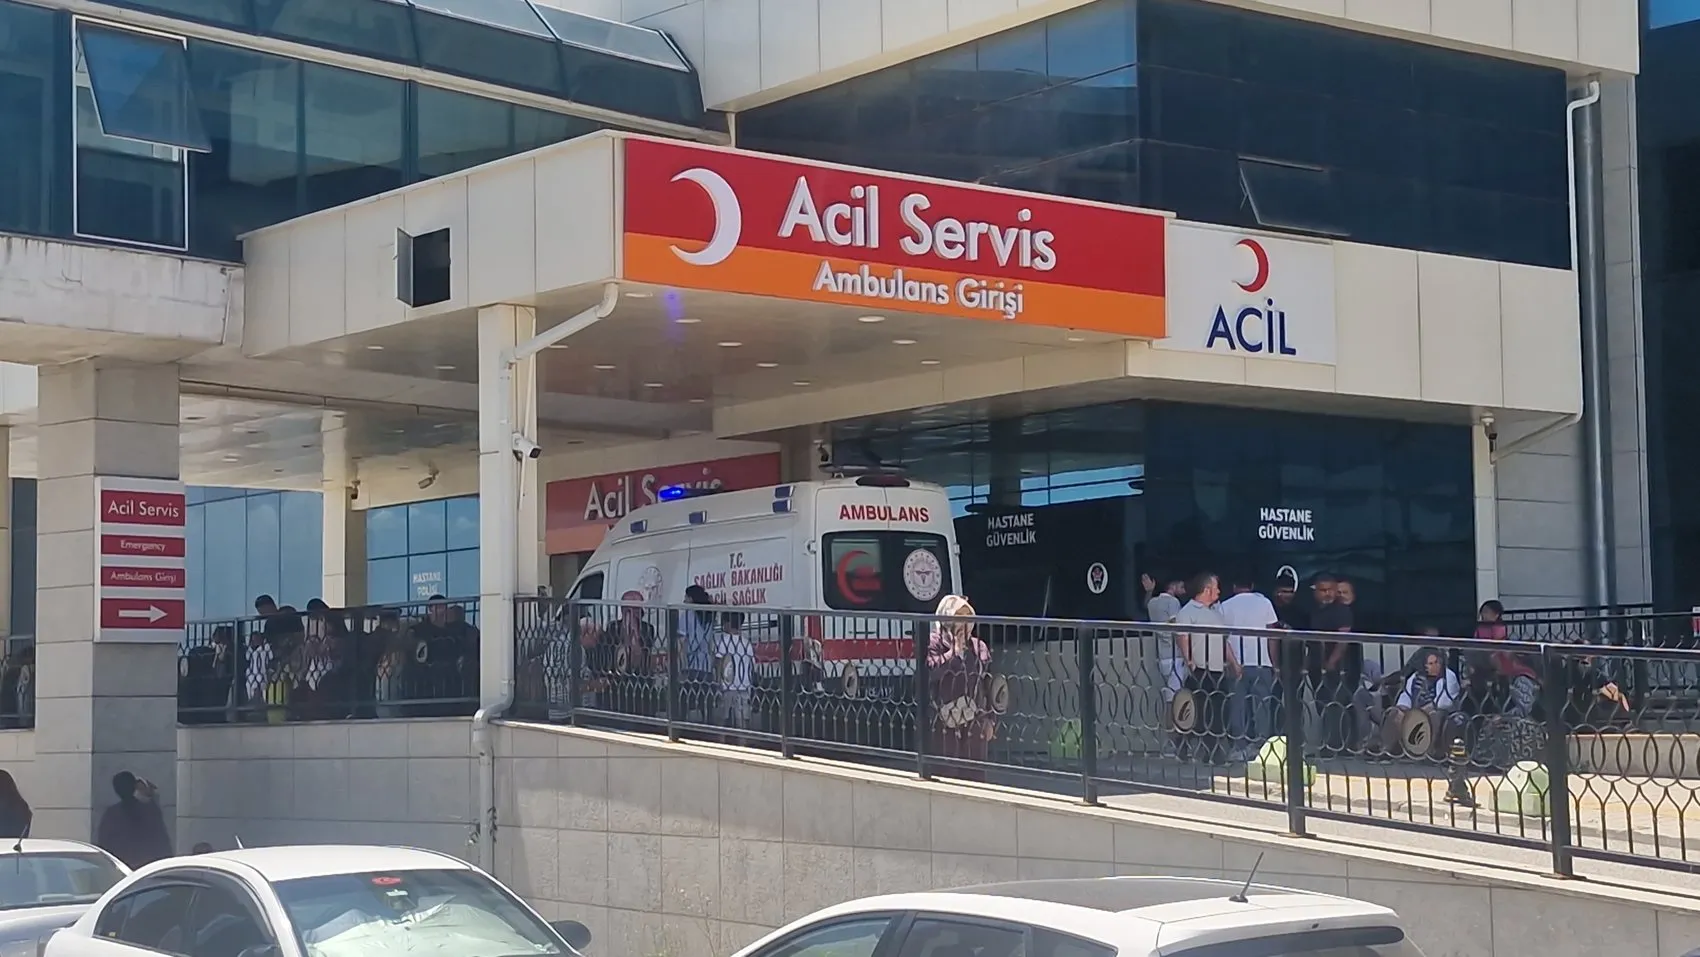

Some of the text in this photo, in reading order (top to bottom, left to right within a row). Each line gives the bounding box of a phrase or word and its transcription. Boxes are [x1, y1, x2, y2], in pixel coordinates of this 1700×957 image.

[777, 175, 1057, 271] Acil Servis
[812, 260, 1024, 320] Ambulans Girişi
[1206, 297, 1297, 356] ACİL
[584, 475, 630, 520] Acil
[108, 500, 179, 517] Acil Servis
[839, 504, 930, 523] AMBULANS
[1260, 507, 1313, 523] HASTANE
[987, 513, 1034, 529] HASTANE
[986, 528, 1036, 547] GÜVENLİK
[1258, 523, 1315, 542] GÜVENLİK
[120, 540, 165, 552] Emergency
[729, 552, 745, 569] T.C.
[110, 571, 153, 581] Ambulans
[694, 563, 783, 589] SAĞLIK BAKANLIĞI
[732, 588, 767, 606] SAĞLIK
